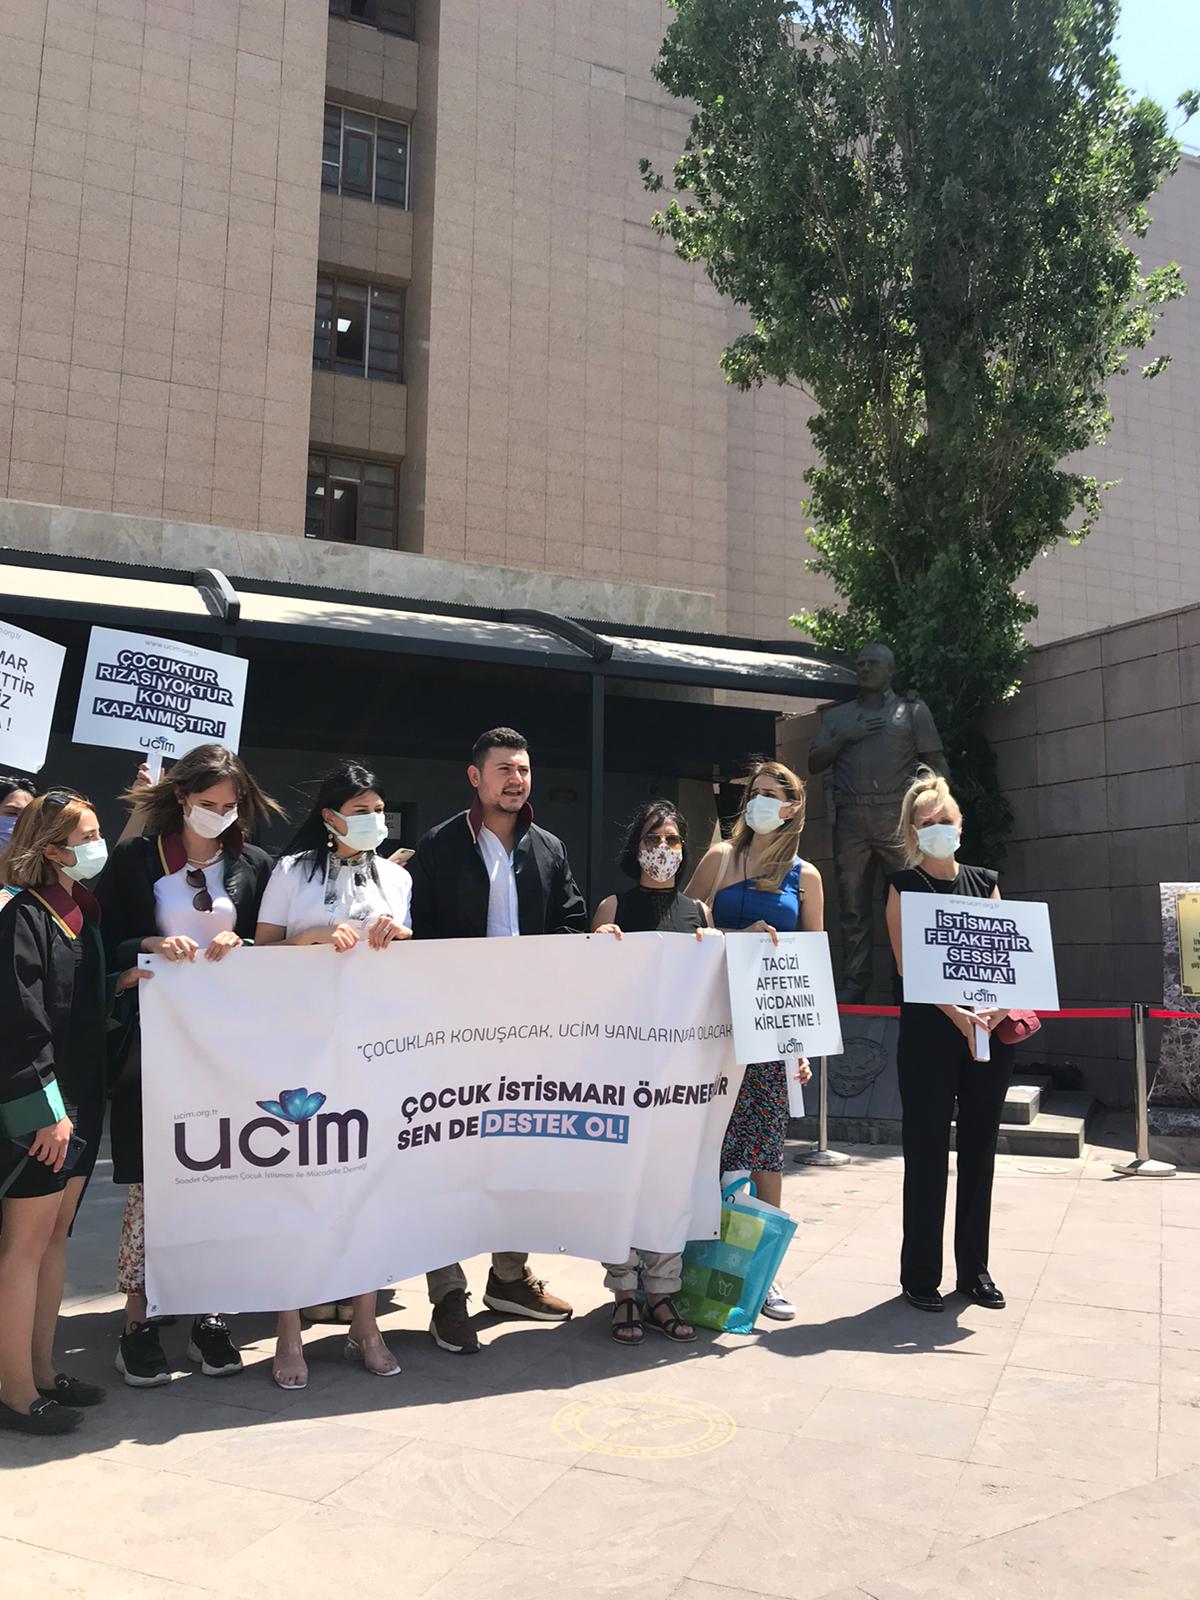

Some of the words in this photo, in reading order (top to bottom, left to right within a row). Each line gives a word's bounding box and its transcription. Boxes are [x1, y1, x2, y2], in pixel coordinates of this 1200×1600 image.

[120, 652, 216, 684] ÇOCUKTUR
[0, 670, 35, 697] TTİR
[99, 666, 157, 687] RIZASI
[161, 676, 231, 704] YOKTUR
[139, 690, 189, 711] KONU
[937, 911, 1015, 933] İSTİSMAR
[927, 930, 1029, 950] FELAKETTİR
[762, 954, 800, 971] TACİZİ
[949, 948, 1008, 966] SESSİZ
[756, 975, 810, 991] AFFETME
[755, 993, 815, 1011] VİCDANINI
[558, 1021, 599, 1038] UCİM
[401, 1083, 492, 1124] ÇOCUK
[498, 1074, 626, 1107] İSTİSMARI
[174, 1108, 369, 1172] ucim
[397, 1121, 441, 1151] SEN
[449, 1116, 479, 1140] DE
[485, 1113, 579, 1136] DESTEK
[584, 1116, 625, 1140] OL!
